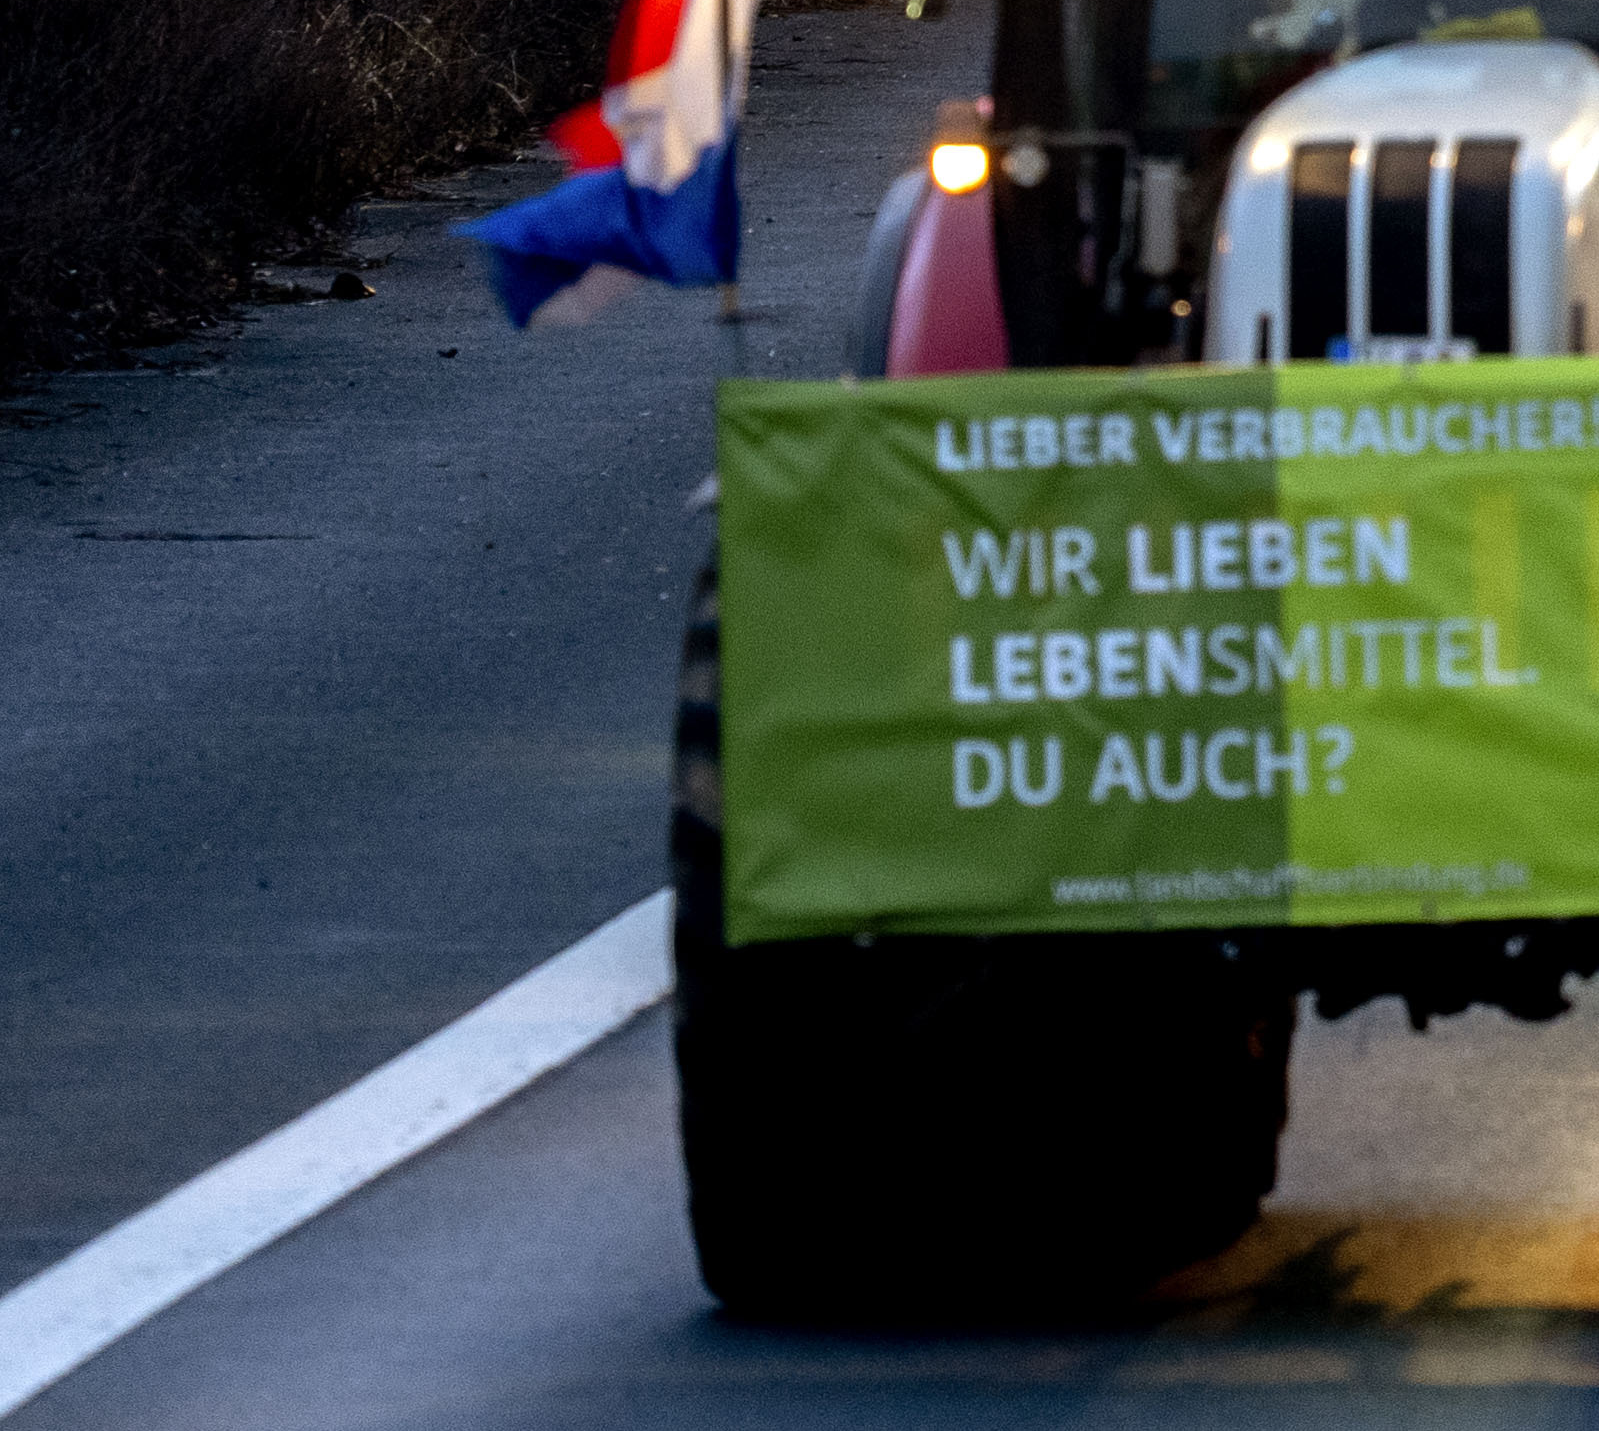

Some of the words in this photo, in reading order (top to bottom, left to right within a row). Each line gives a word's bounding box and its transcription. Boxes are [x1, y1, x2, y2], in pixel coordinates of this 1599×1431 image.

[936, 415, 1138, 471] LIEBER
[942, 525, 1101, 599] WIR
[1128, 515, 1411, 594] LIEBEN
[950, 617, 1540, 704] LEBENSMITTEL.
[953, 736, 1064, 808] DU
[1090, 724, 1356, 804] AUCH?
